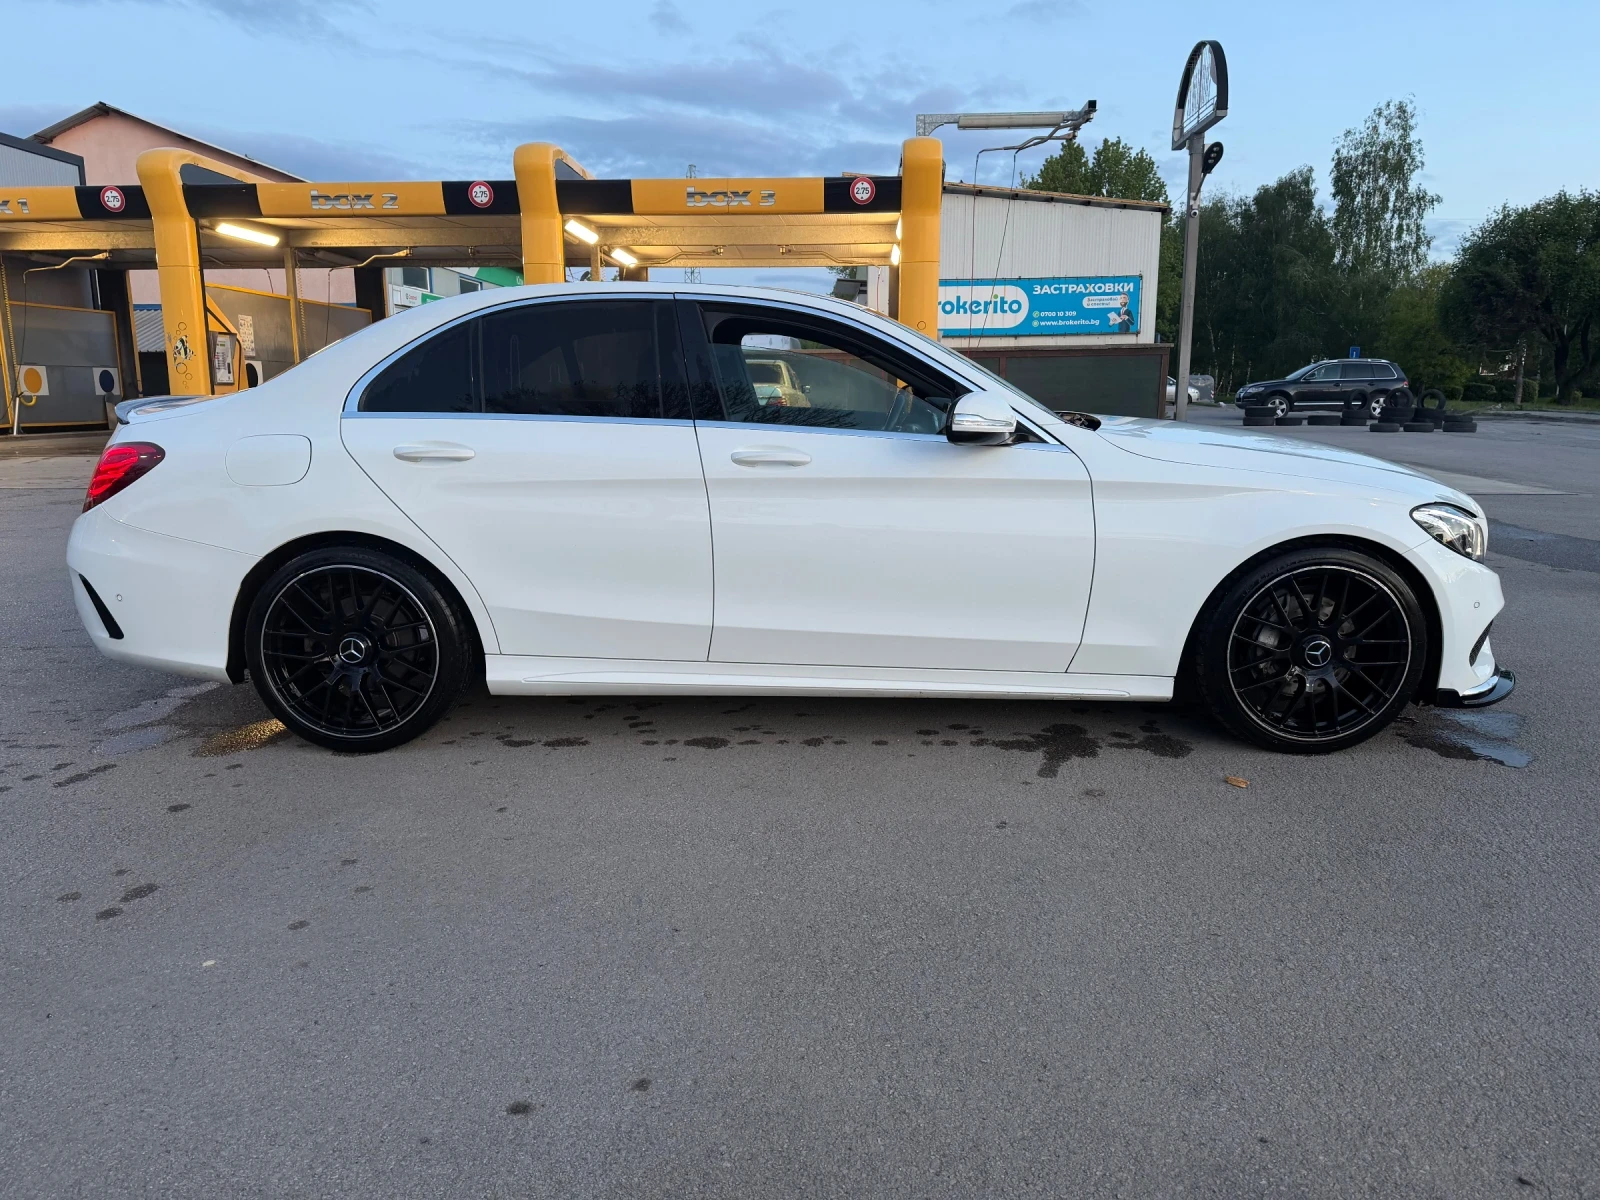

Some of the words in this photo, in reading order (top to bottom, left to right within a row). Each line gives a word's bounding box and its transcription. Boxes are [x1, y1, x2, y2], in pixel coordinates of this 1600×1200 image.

[106, 195, 120, 203] 2.75
[310, 190, 376, 210] box
[381, 193, 399, 209] 2
[473, 190, 488, 198] 2.75
[686, 186, 752, 207] box
[759, 190, 776, 206] 3
[17, 198, 30, 214] 1
[1032, 282, 1134, 295] ЗАСТРАХОВКИ
